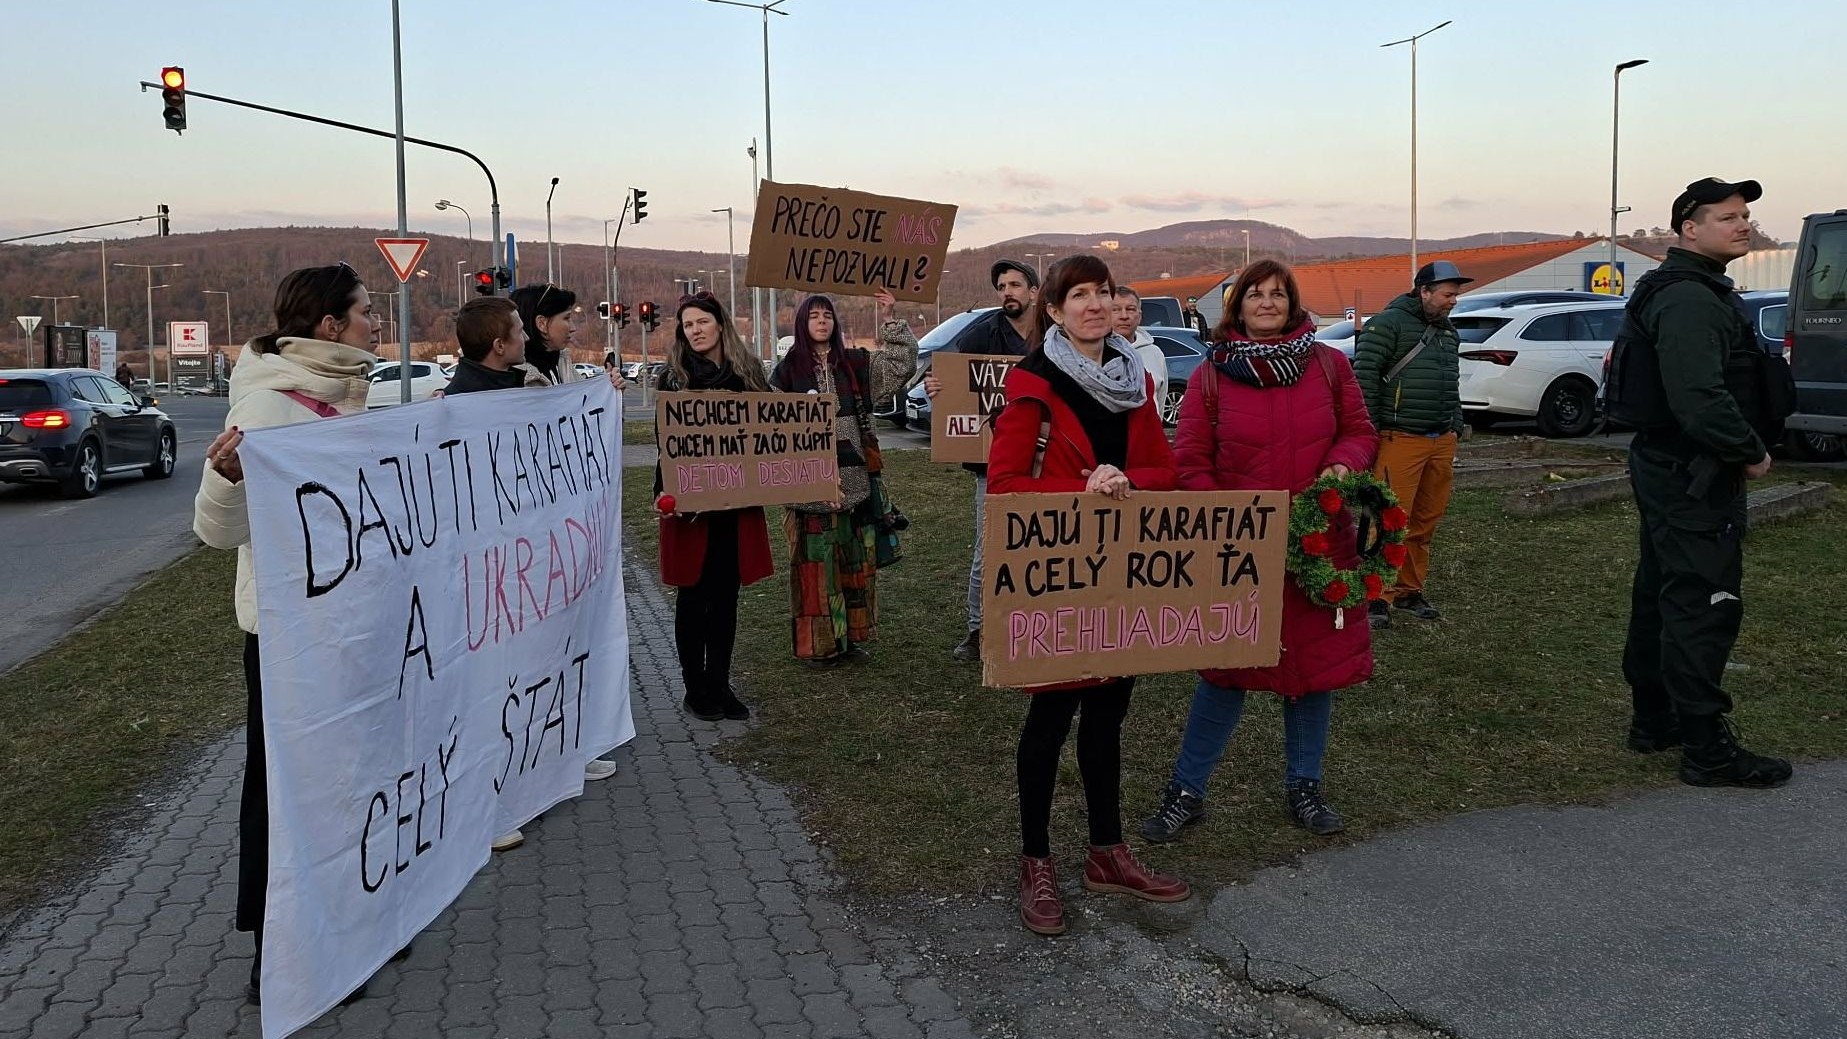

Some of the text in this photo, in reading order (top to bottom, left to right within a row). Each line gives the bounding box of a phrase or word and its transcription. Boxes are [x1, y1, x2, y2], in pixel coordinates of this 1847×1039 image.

[772, 196, 942, 245] PREČO STE NÁS
[785, 247, 929, 291] NEPOZVALI?
[971, 359, 1016, 388] VÁŽ
[666, 397, 832, 426] NECHCEM KARAFIÁT,
[948, 417, 977, 435] ALE
[981, 392, 1009, 414] VO
[666, 434, 714, 458] CHCEM
[720, 428, 748, 456] MAŤ
[793, 427, 833, 453] KÚPIŤ
[758, 458, 836, 486] DESIATU
[296, 395, 611, 599] DAJÚ TI KARAFIÁT
[1005, 495, 1276, 550] DAJÚ TI KARAFIÁT
[994, 543, 1259, 597] A CELÝ ROK ŤA
[398, 585, 434, 700] A
[1009, 590, 1260, 661] PREHLIADAJÚ
[361, 635, 590, 893] CELÝ ŠTÁT
